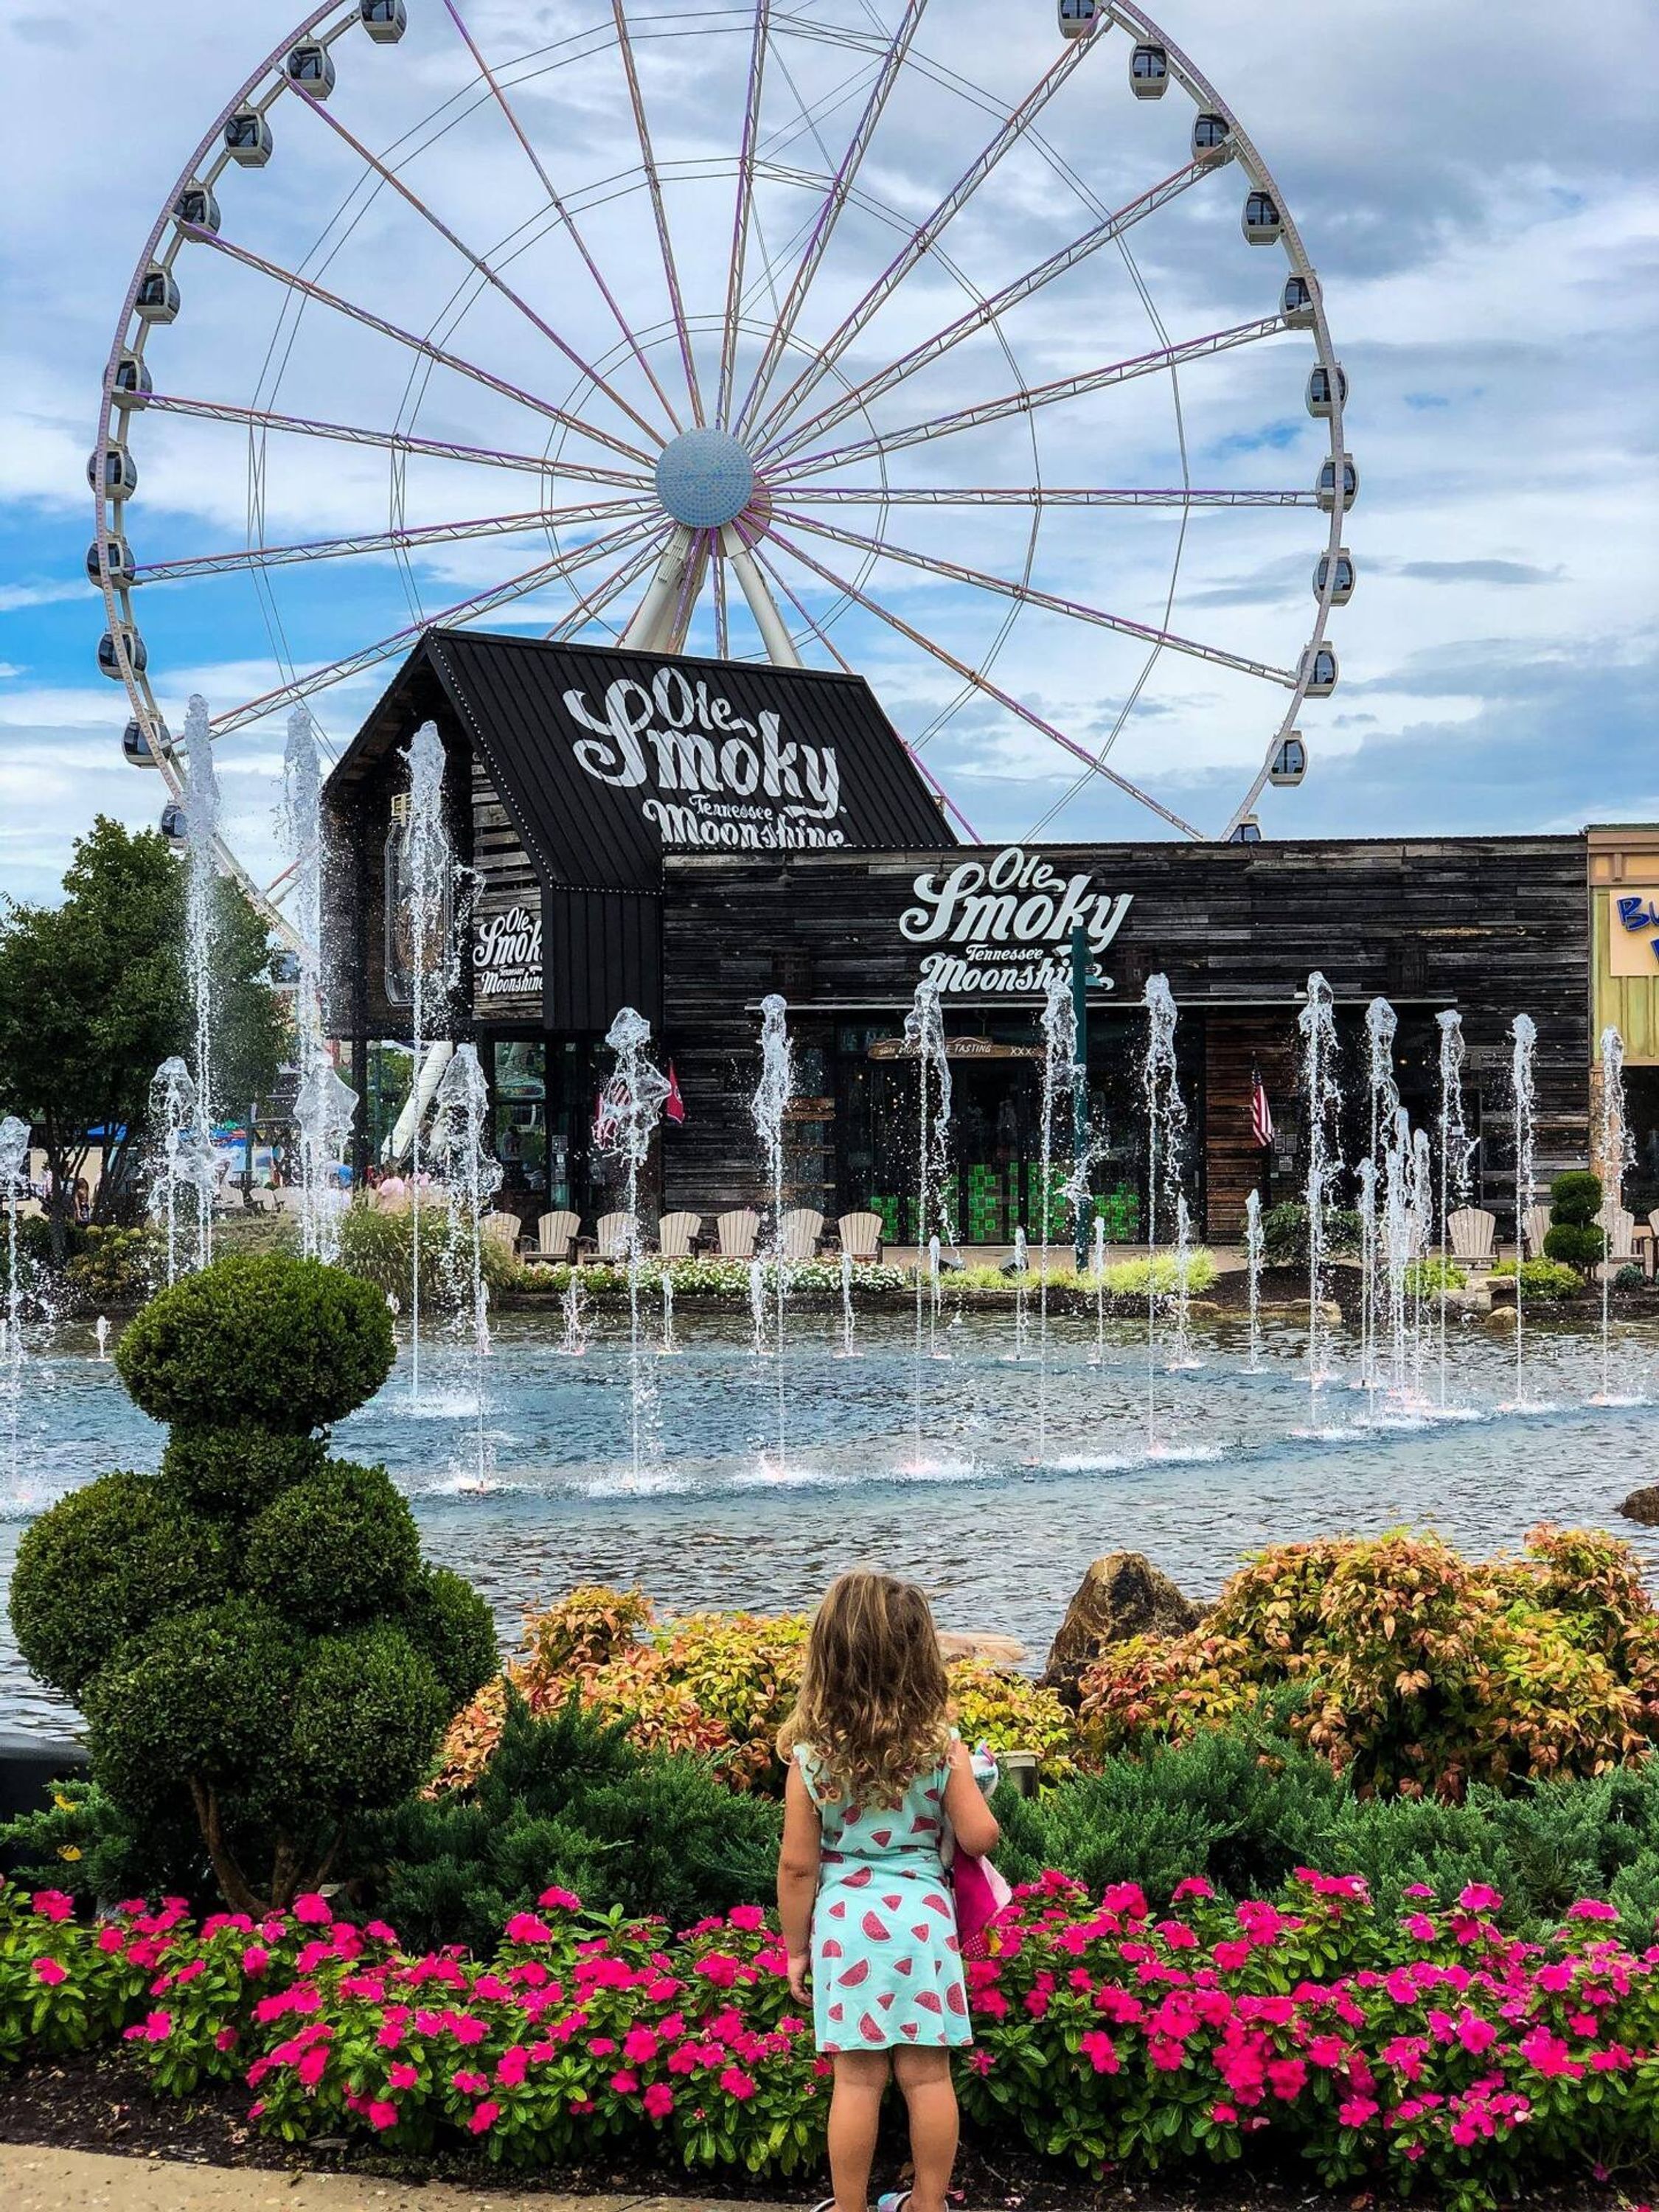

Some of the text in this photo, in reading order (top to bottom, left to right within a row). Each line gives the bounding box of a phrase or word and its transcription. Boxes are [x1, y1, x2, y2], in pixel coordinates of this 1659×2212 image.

[653, 667, 757, 737] Ole
[563, 678, 846, 818] Smoky
[642, 799, 853, 848] Moonshine
[689, 794, 773, 820] Tennessee
[989, 847, 1067, 892] Ole
[506, 907, 533, 933] Ole
[899, 861, 1134, 953] Smoky
[473, 916, 543, 972] Smok
[966, 944, 1043, 961] Tennessee
[954, 1043, 992, 1054] TASTING
